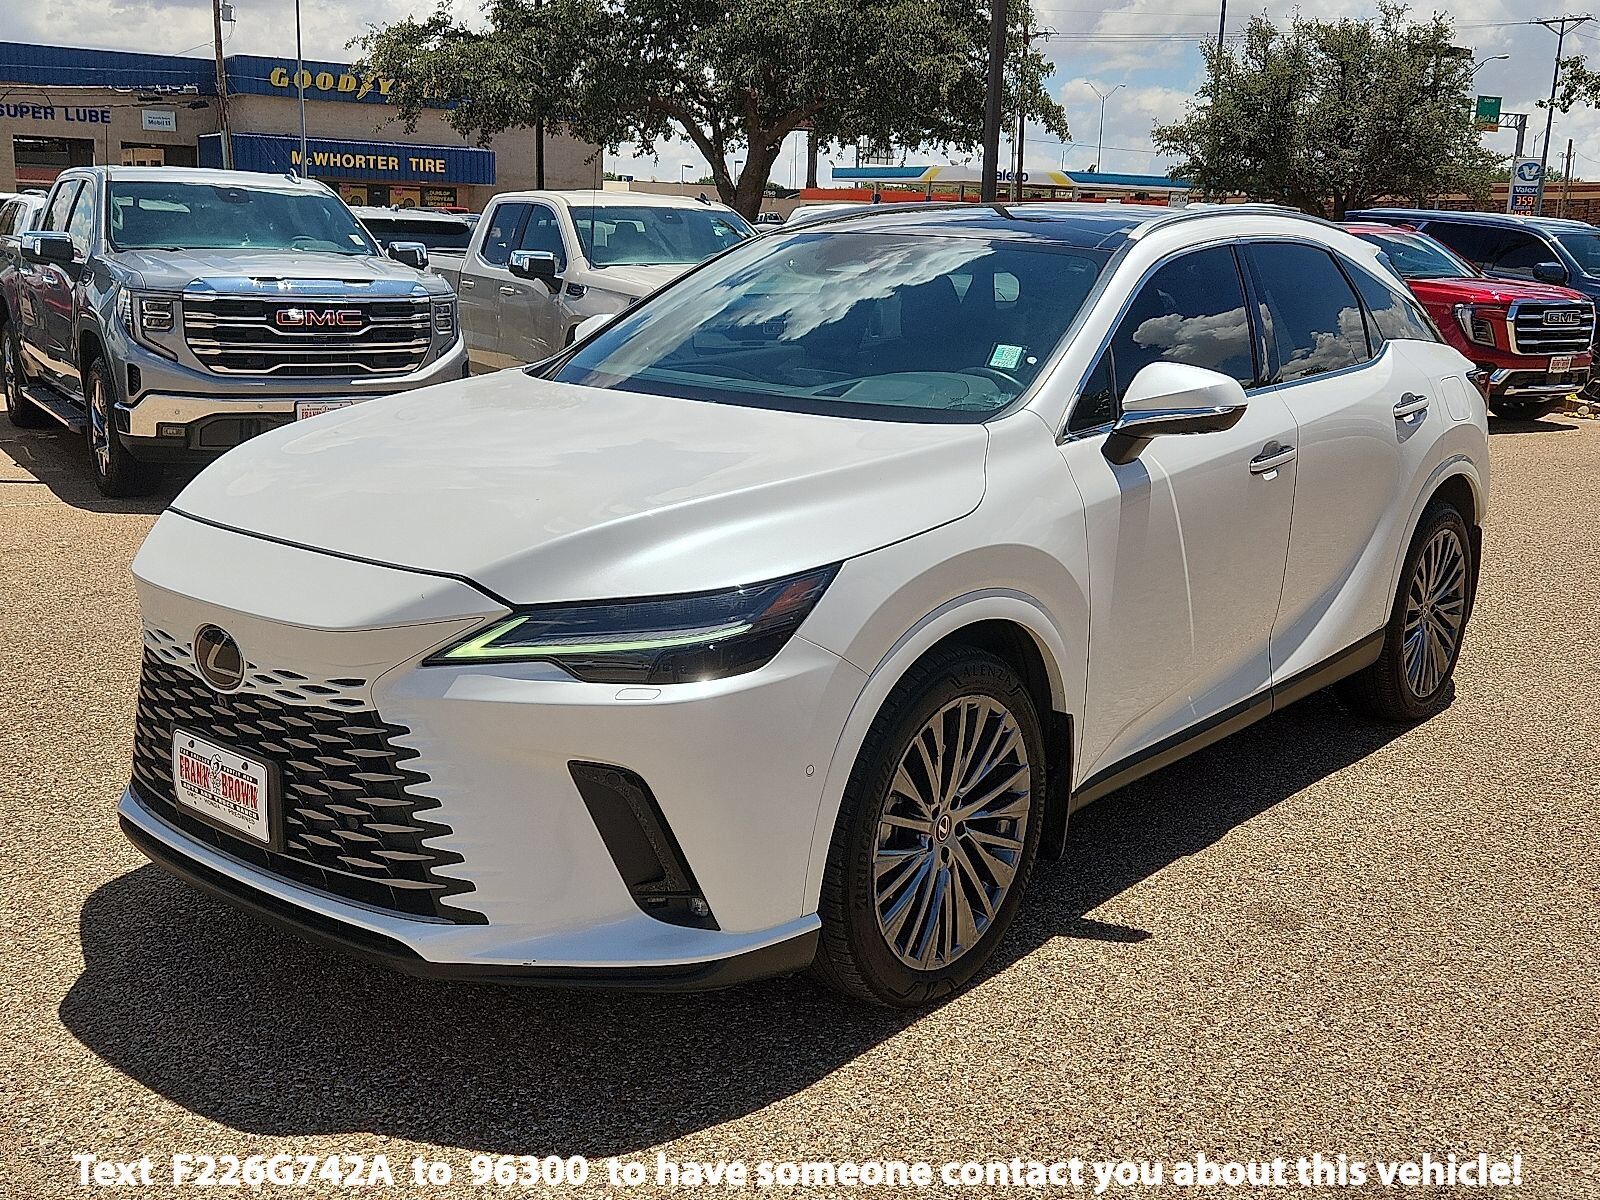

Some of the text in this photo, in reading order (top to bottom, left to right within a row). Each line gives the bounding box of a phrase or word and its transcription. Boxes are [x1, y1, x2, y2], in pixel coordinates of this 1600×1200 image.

[270, 67, 396, 95] GOODY
[65, 107, 111, 124] LUBE
[409, 157, 446, 173] TIRE
[996, 169, 1029, 182] aleo
[1516, 195, 1533, 206] 359
[276, 309, 362, 326] GMC
[1547, 312, 1580, 323] GMC
[963, 664, 1012, 687] ALENZA
[179, 754, 259, 811] FRANK BROWN
